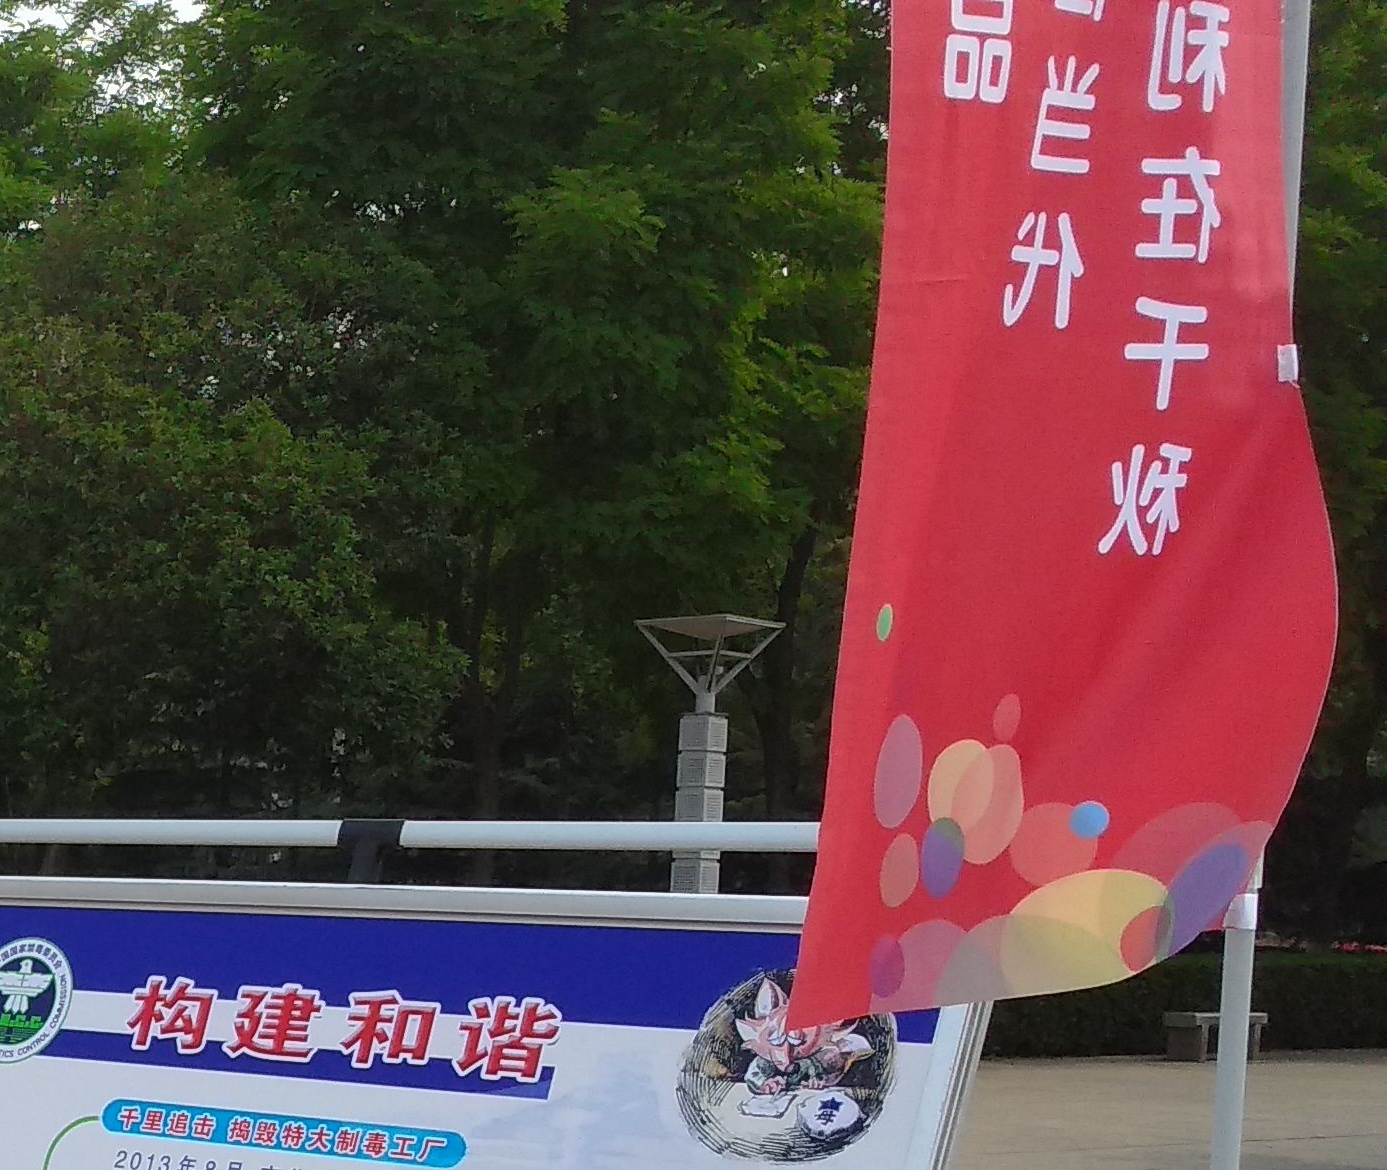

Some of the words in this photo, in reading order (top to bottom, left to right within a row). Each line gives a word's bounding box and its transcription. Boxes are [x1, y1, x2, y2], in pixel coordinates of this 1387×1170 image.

[17, 1032, 50, 1056] CONTROL
[49, 974, 67, 1029] COMMISSION
[126, 973, 562, 1085] 构建和谐
[119, 1107, 216, 1138] 千里追击
[228, 1117, 449, 1161] 捣毁特大制毒工厂
